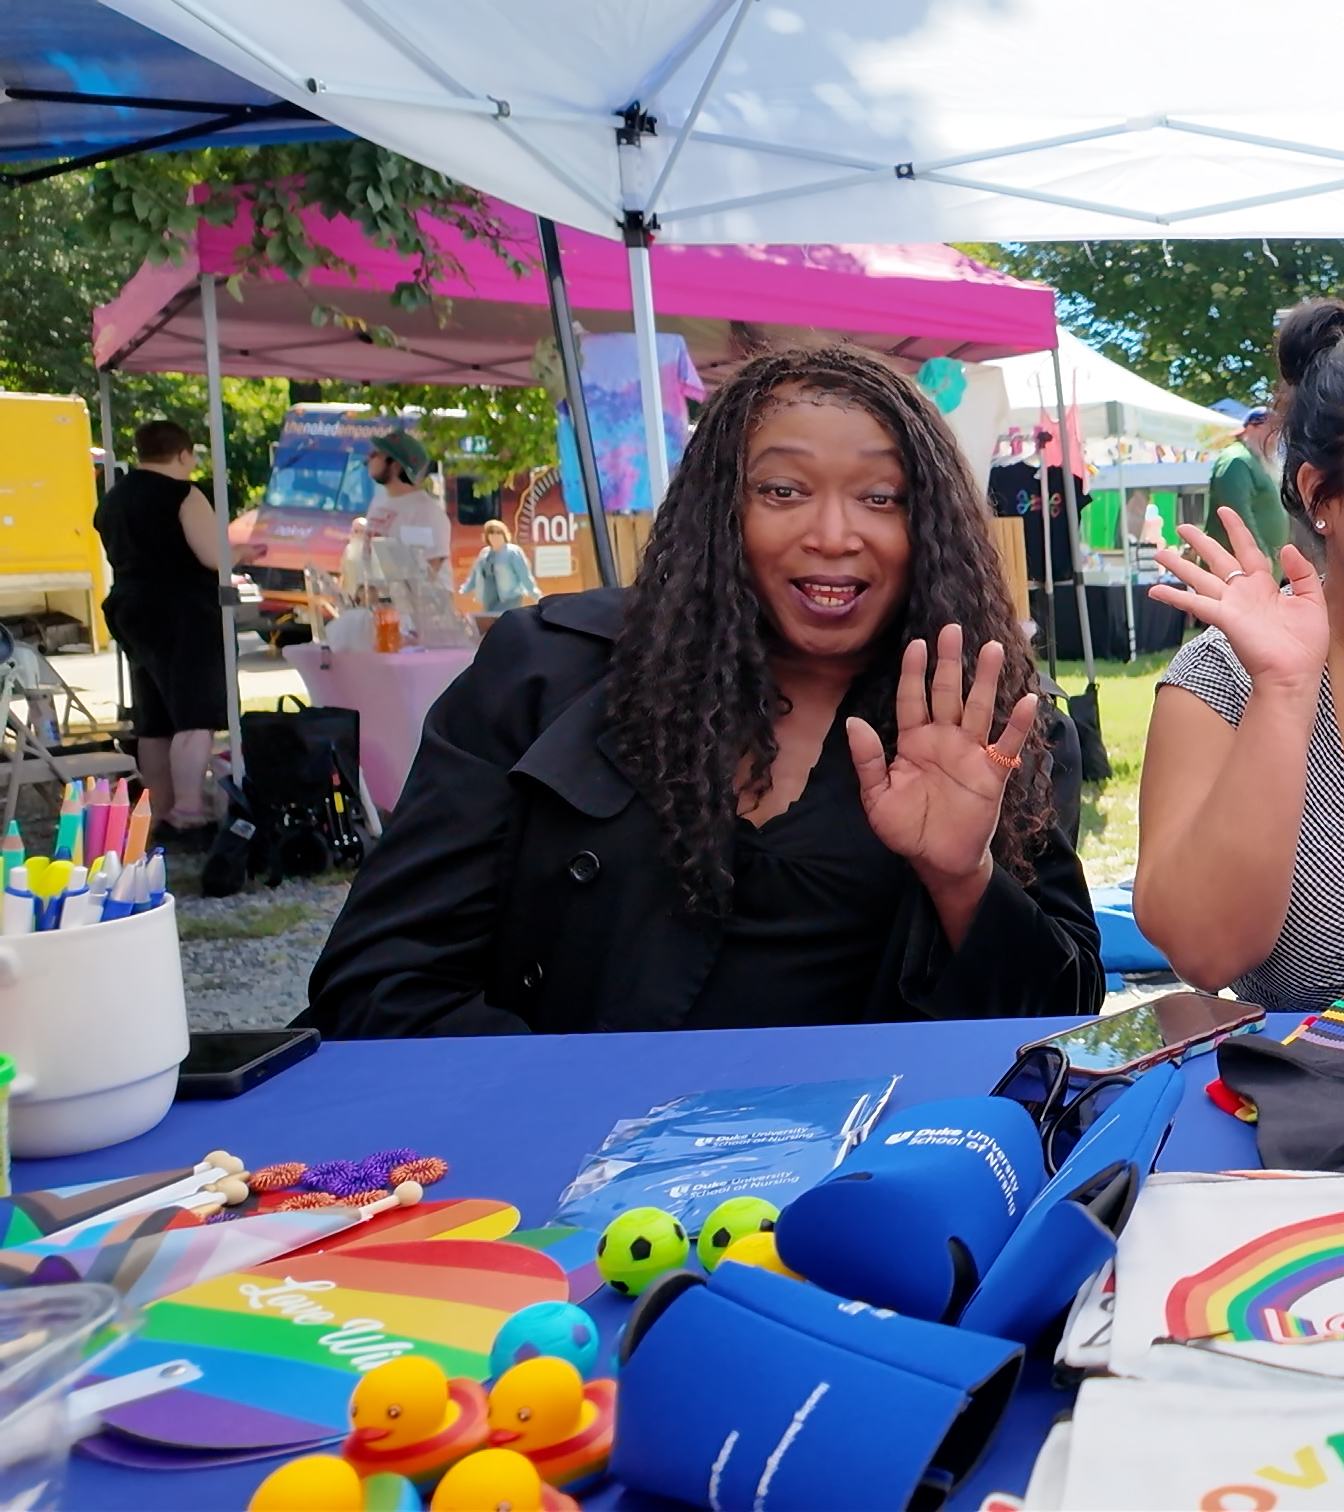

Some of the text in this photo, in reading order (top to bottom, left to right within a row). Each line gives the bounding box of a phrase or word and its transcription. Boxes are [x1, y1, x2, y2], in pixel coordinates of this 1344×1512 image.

[712, 1138, 750, 1148] School
[766, 1132, 815, 1144] Nursing
[715, 1127, 809, 1143] Duke University
[914, 1127, 963, 1137] Duke
[966, 1130, 1019, 1192] University
[690, 1186, 731, 1199] School
[749, 1176, 800, 1190] Nursing
[692, 1170, 794, 1192] Duke University
[908, 1136, 1016, 1217] School of Nursing
[238, 1275, 337, 1326] Love
